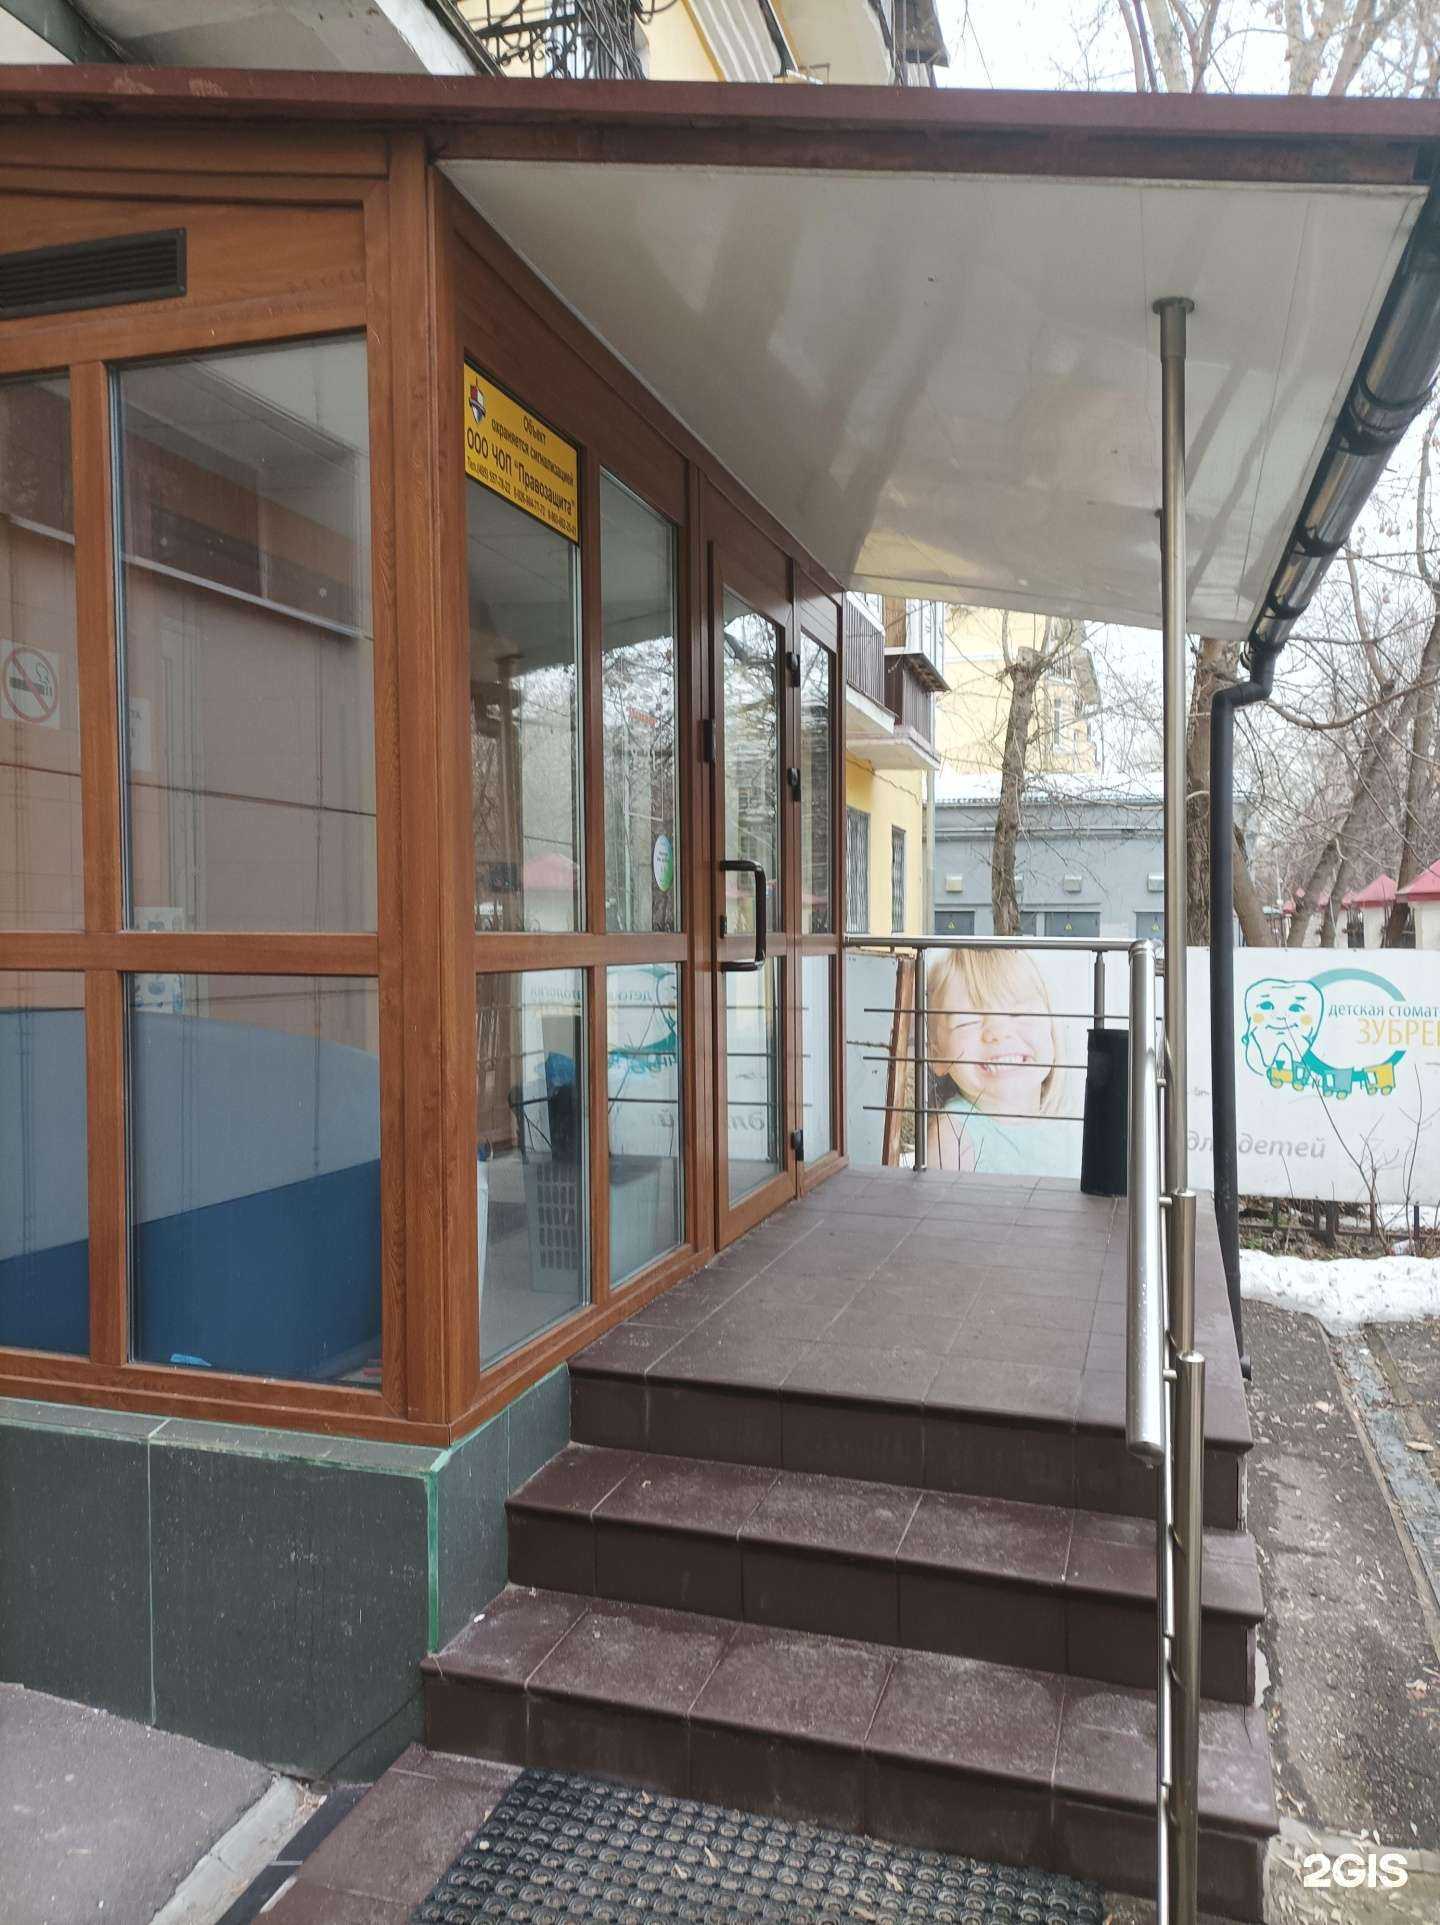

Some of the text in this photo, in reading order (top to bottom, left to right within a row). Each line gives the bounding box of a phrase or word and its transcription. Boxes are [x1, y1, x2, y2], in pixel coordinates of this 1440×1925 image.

[522, 415, 546, 446] Объект
[491, 418, 575, 488] охраняется сигнализацией
[467, 427, 576, 516] ООО ЧОП "Правозащита"
[1328, 1003, 1440, 1018] детская стомат
[1356, 1018, 1440, 1047] ЗУБРЕ
[1187, 1130, 1326, 1159] дл детей
